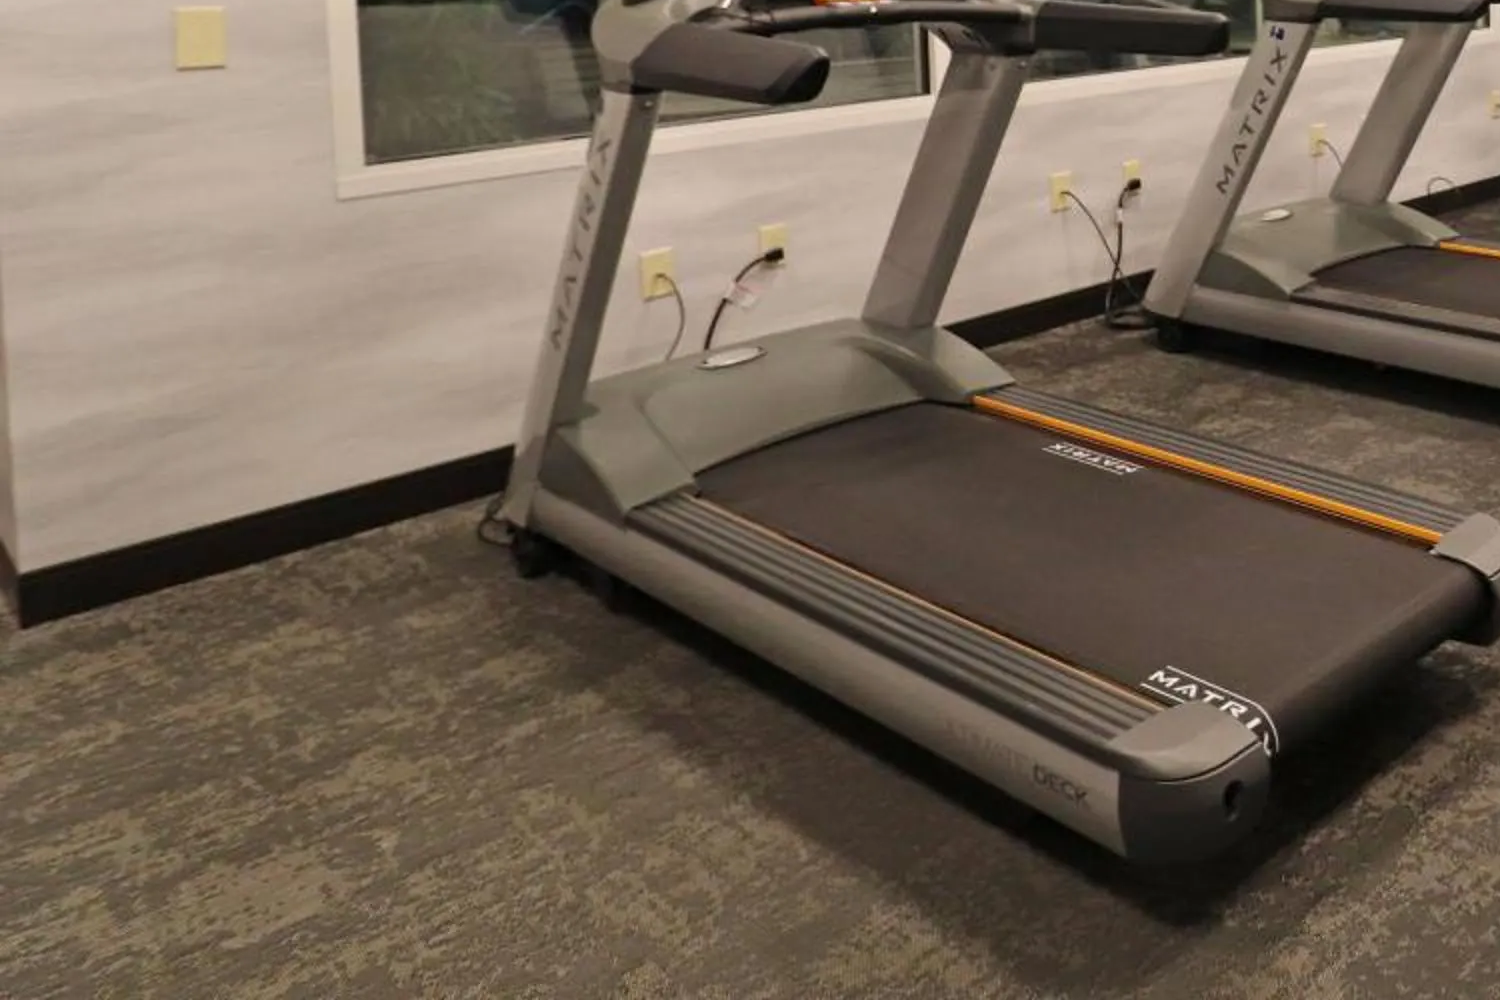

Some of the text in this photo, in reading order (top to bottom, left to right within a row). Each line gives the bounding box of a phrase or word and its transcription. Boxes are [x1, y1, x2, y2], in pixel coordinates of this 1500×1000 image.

[1216, 46, 1288, 194] MATRIX
[551, 139, 612, 351] MATRIX
[1032, 761, 1090, 808] DECK
